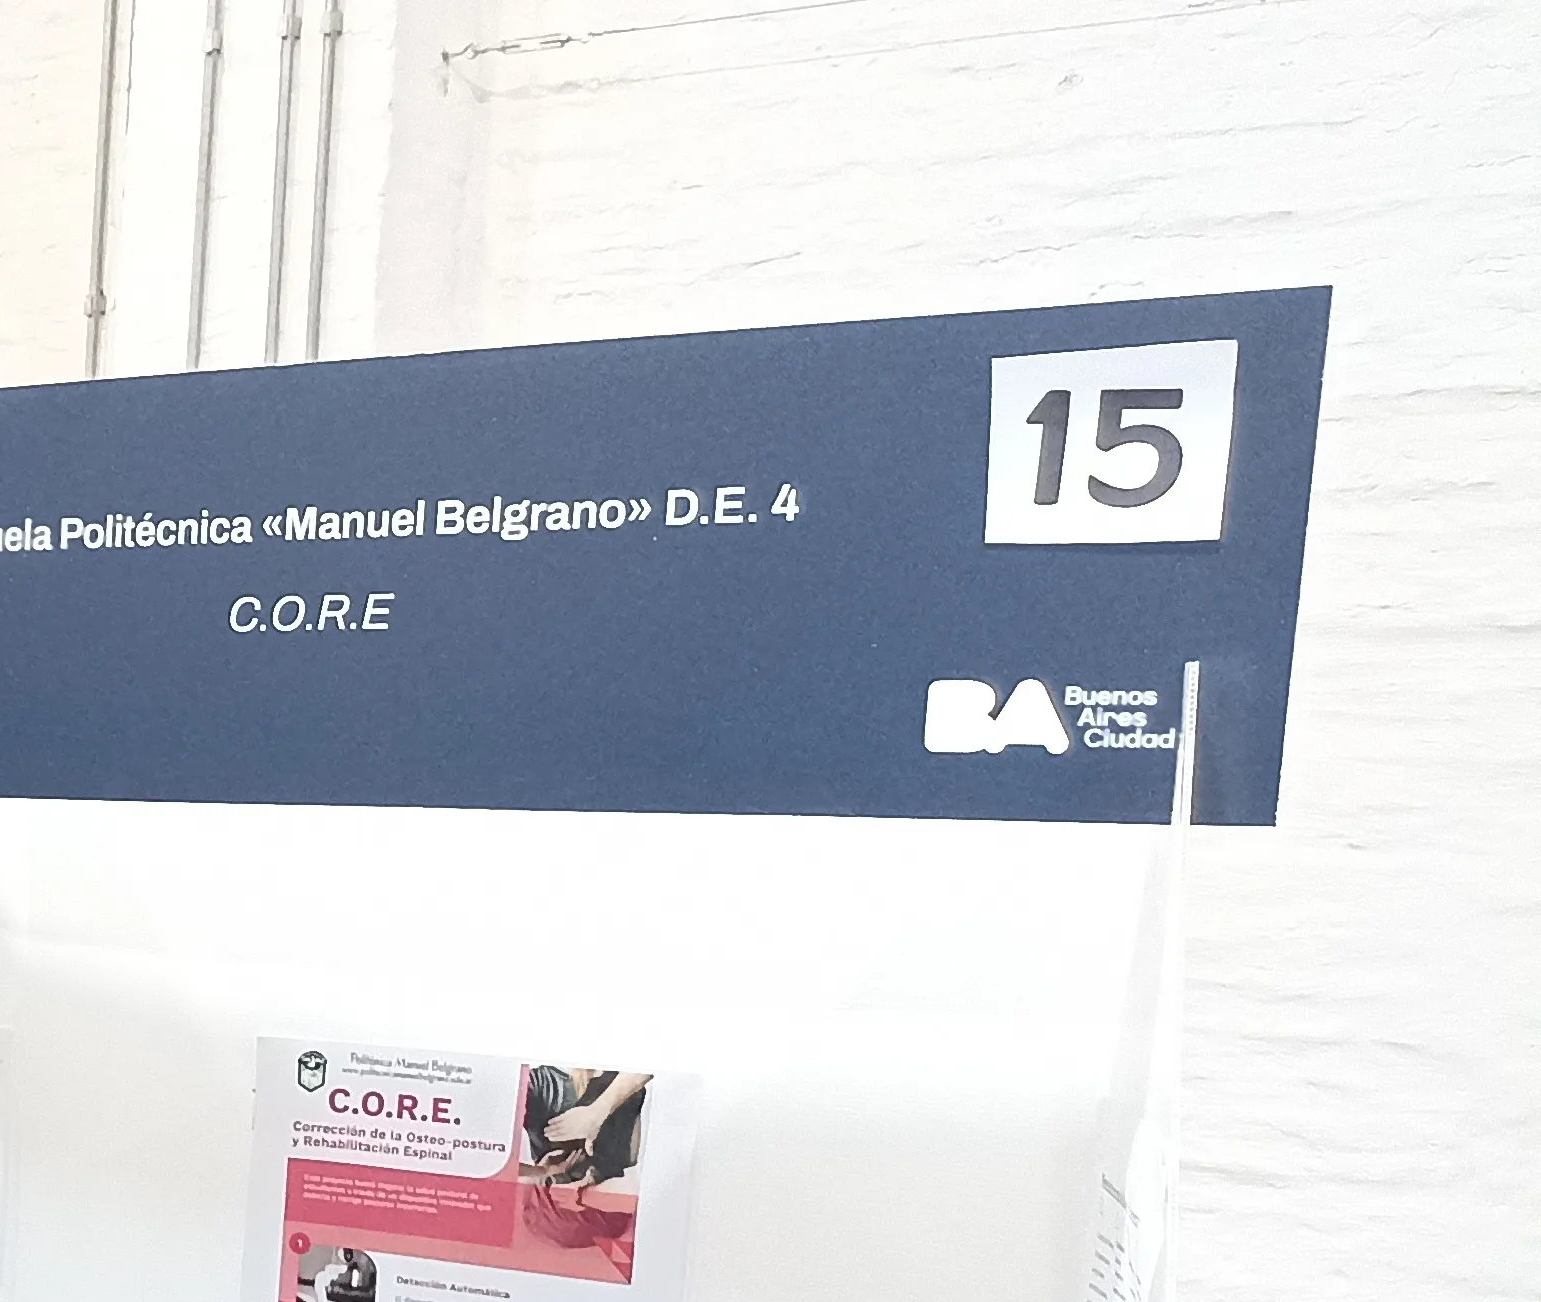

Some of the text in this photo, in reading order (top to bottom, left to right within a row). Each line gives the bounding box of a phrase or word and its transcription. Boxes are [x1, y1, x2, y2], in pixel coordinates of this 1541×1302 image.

[1026, 387, 1184, 507] 15
[60, 509, 252, 549] Politécnica
[263, 499, 425, 541] «Manuel
[435, 496, 652, 541] Belgrano»
[664, 486, 758, 527] D.E.
[770, 483, 800, 522] 4
[228, 593, 395, 633] C.O.R.E
[1064, 685, 1158, 706] Buenos
[924, 678, 1069, 755] BA
[1077, 707, 1148, 727] Aires
[1084, 728, 1176, 749] Ciudad
[328, 1087, 461, 1126] C.O.R.E.
[292, 1136, 453, 1161] y Rehabilitación Espinal
[293, 1120, 506, 1153] Corrección de la Osteo-postura
